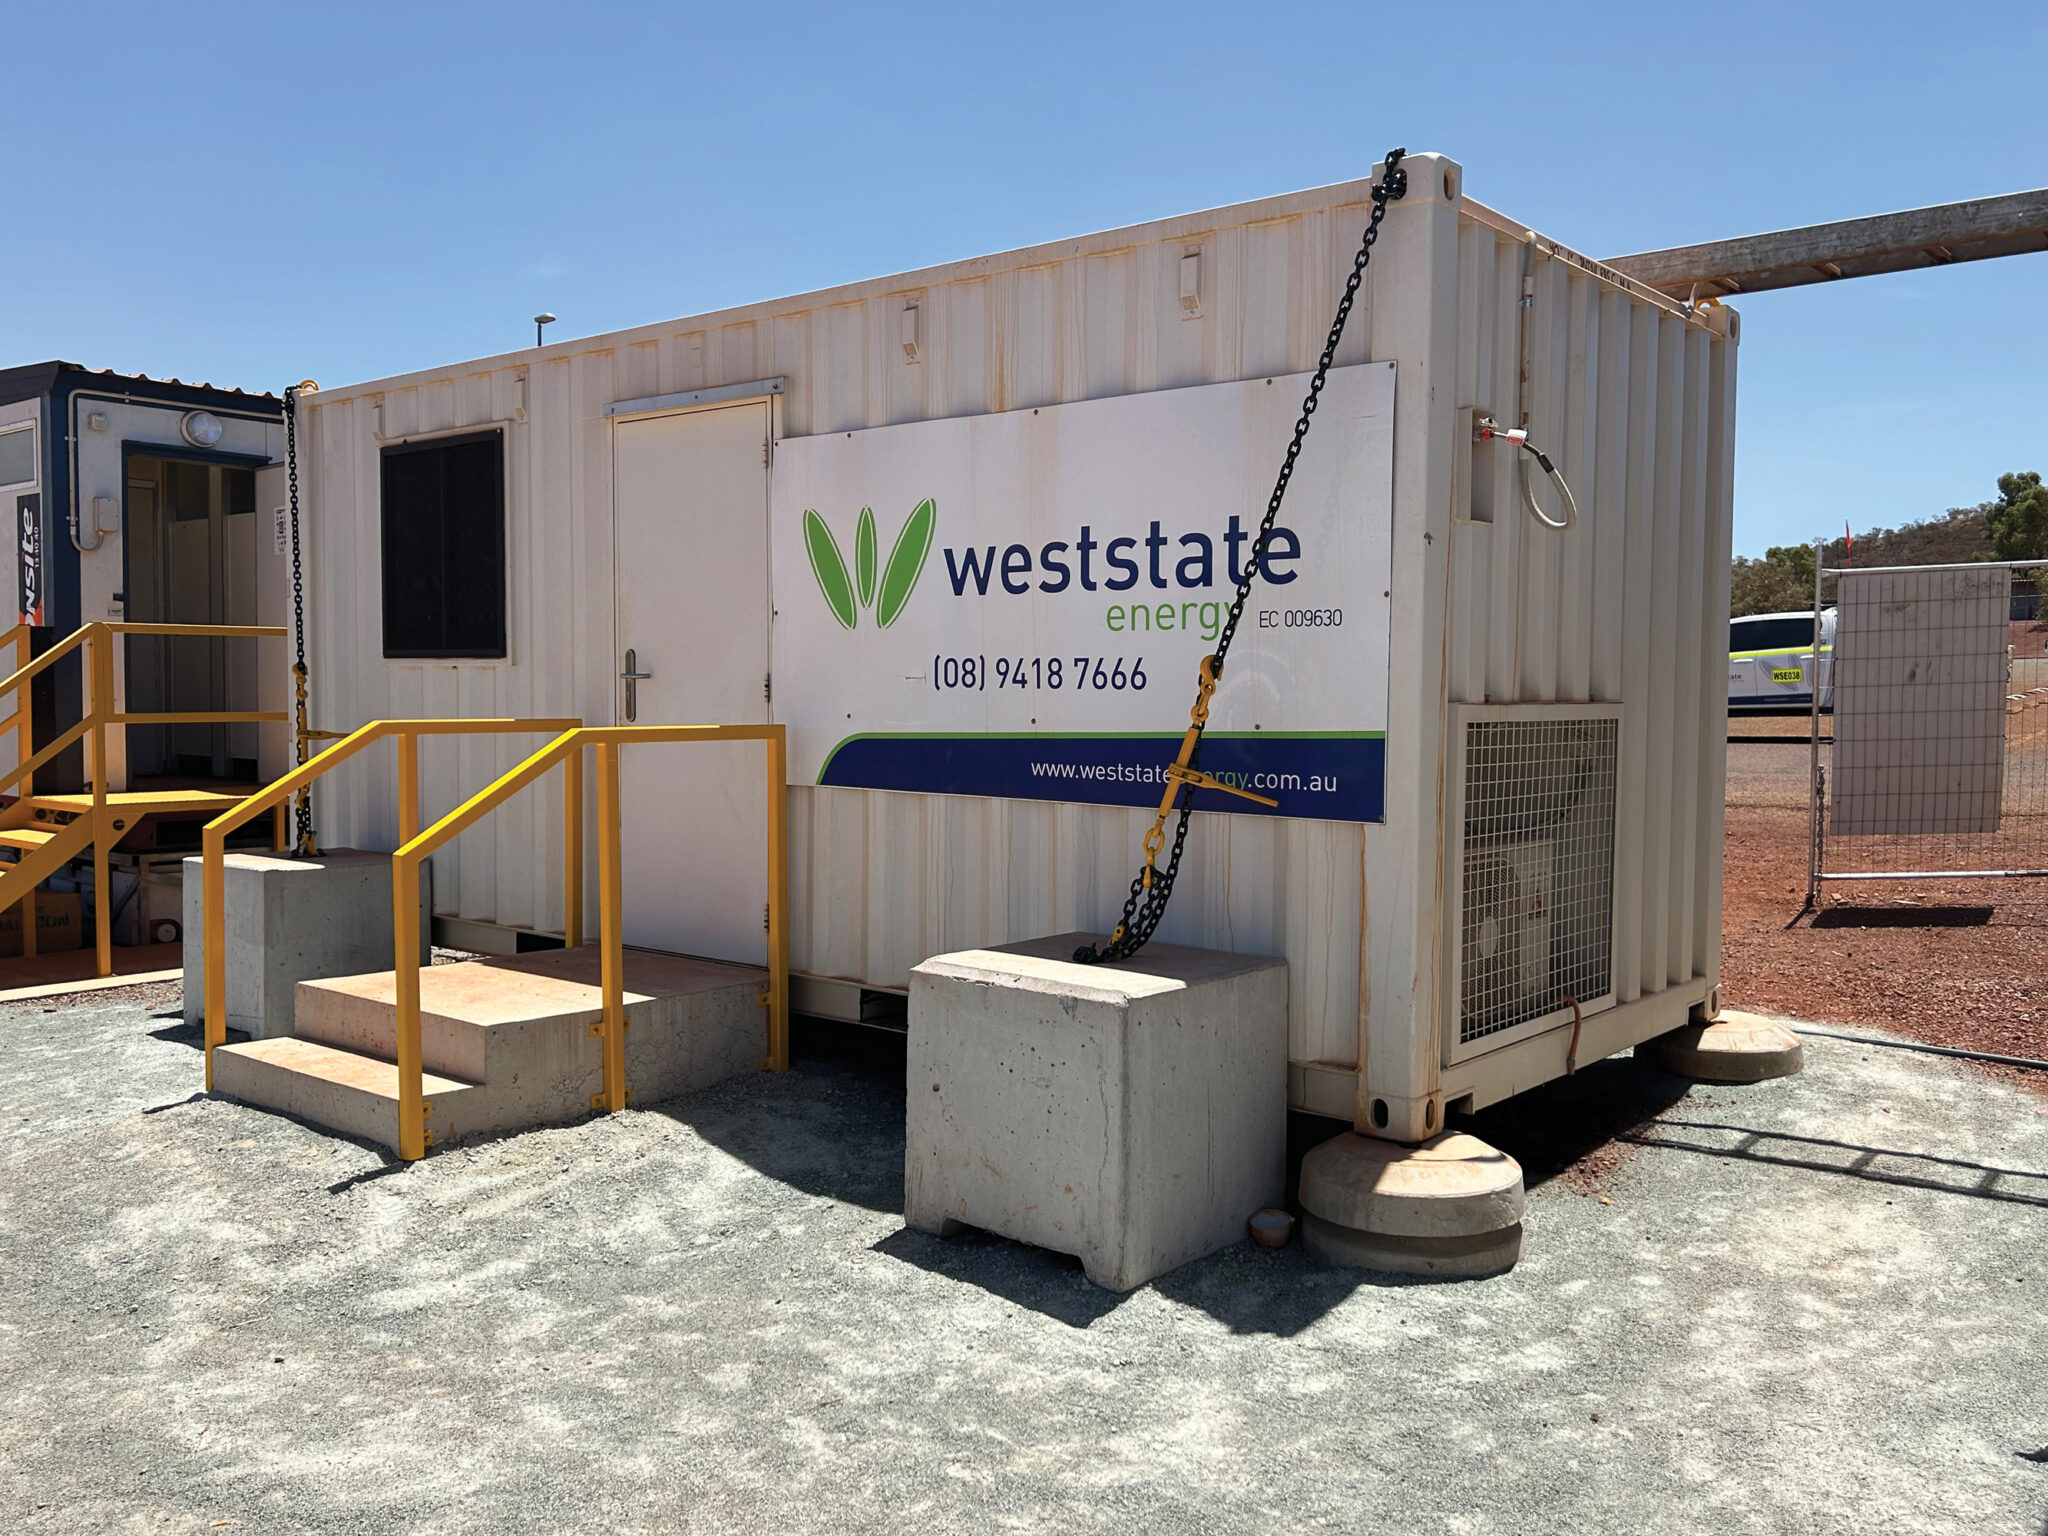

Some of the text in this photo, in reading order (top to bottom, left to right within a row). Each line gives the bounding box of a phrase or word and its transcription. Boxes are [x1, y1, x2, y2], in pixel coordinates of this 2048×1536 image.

[944, 515, 1301, 597] weststate
[1259, 609, 1343, 628] EC 009630
[934, 654, 1147, 691] (08) 9418 7666
[1773, 671, 1800, 681] WSE038
[1031, 760, 1337, 793] www.weststatergy.com.au
